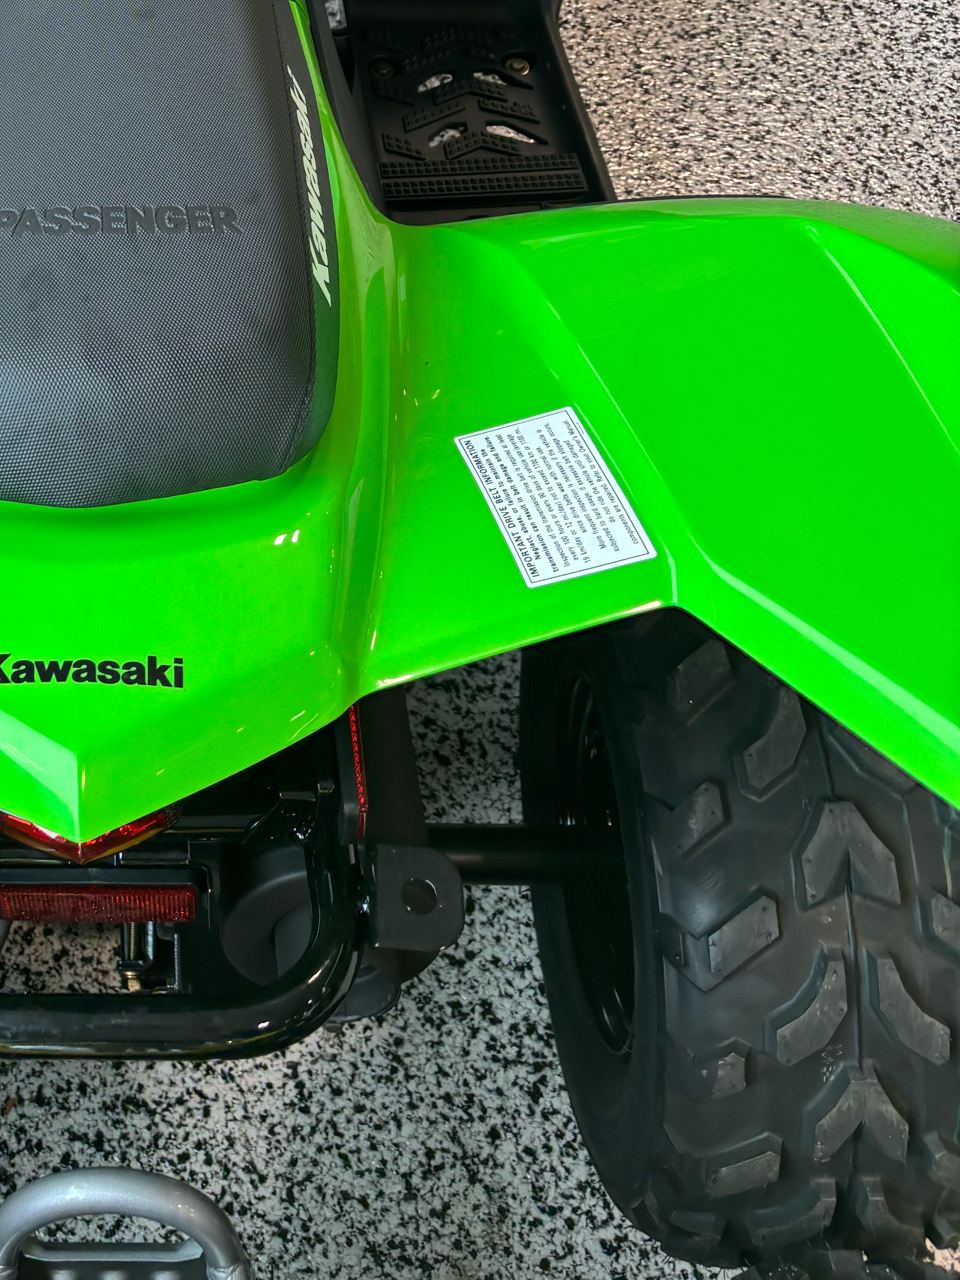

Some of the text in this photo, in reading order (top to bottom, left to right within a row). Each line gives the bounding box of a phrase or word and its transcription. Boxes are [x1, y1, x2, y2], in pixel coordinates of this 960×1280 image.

[286, 64, 332, 307] Kawasaki
[492, 452, 501, 462] and
[485, 458, 500, 479] maintain
[499, 463, 513, 483] damage
[502, 488, 514, 505] failure
[510, 484, 519, 495] belt
[463, 439, 539, 577] IMPORTANT DRIVE BELT INFORMATION
[520, 504, 532, 520] result
[530, 521, 538, 532] can
[536, 533, 558, 572] transmission
